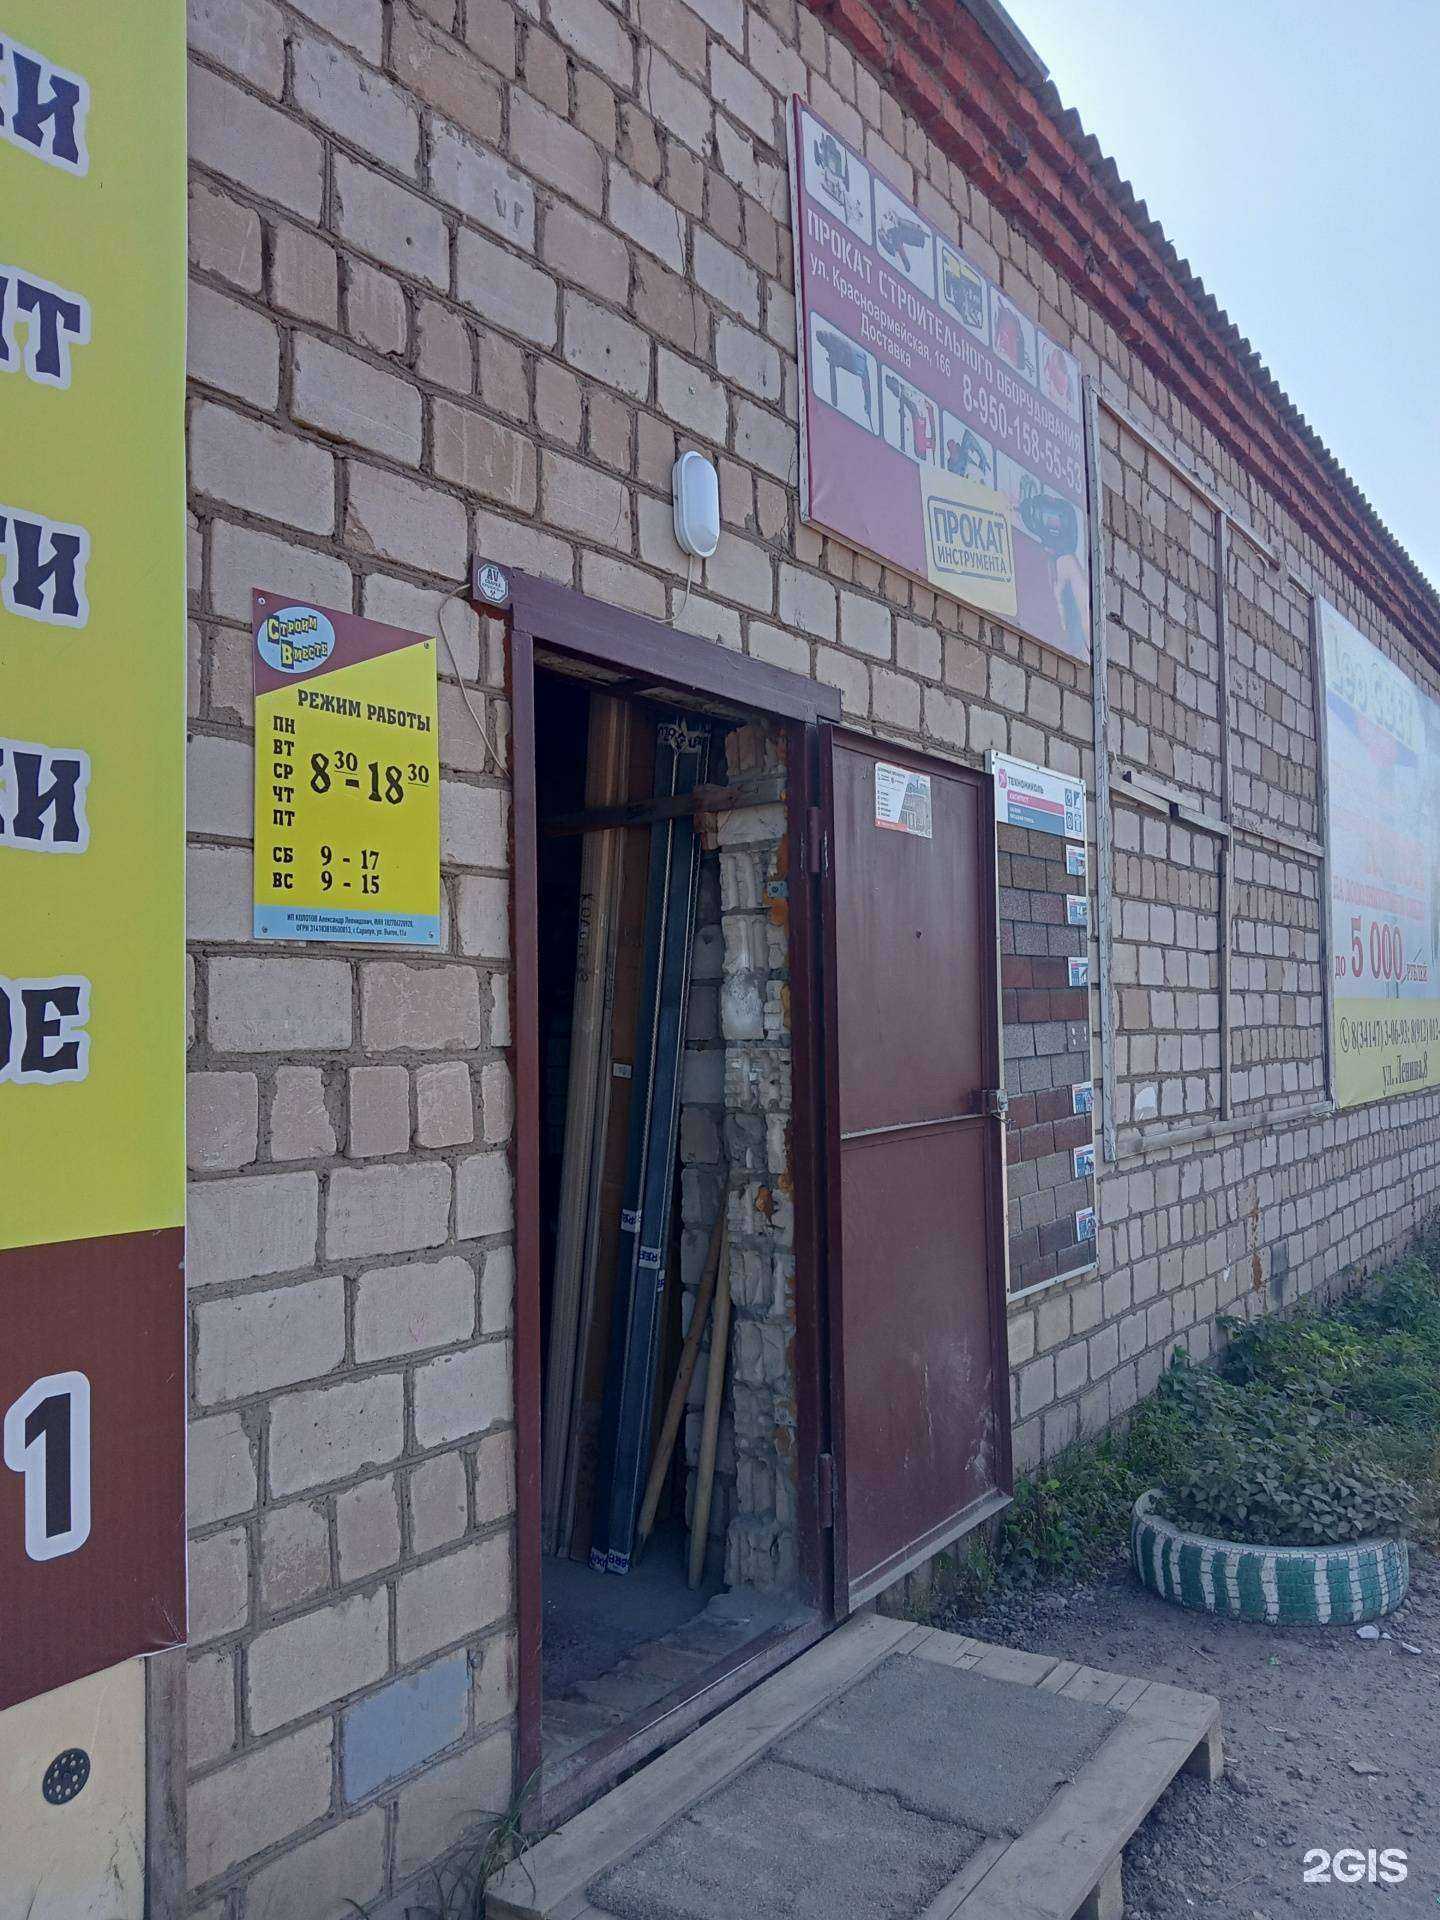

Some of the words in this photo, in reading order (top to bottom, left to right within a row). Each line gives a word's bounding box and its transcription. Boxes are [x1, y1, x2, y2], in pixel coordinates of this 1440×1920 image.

[0, 40, 84, 170] И
[0, 272, 85, 383] Т
[807, 208, 873, 285] ПРОКАТ
[878, 270, 993, 384] СТРОИТЕЛЬНОГО
[996, 370, 1081, 453] ОБОРУДОВАНИЯ
[810, 253, 829, 282] ул.
[832, 267, 933, 367] Красноармейская,
[934, 351, 951, 377] 166
[860, 312, 912, 369] Доставка
[962, 374, 1082, 495] 8-950-158-55-53
[933, 507, 1004, 554] ПРОКАТ
[0, 512, 85, 622] И
[937, 545, 1007, 574] ИНСТРУМЕНТА
[273, 715, 295, 734] ПН
[297, 688, 362, 718] РЕЖИМ
[367, 704, 431, 732] РАБОТЫ
[273, 739, 294, 756] ВТ
[273, 763, 293, 779] СР
[0, 744, 85, 846] И
[272, 785, 294, 803] ЧТ
[273, 809, 295, 826] ПТ
[272, 846, 293, 863] СБ
[320, 845, 332, 866] 9
[361, 850, 379, 870] 17
[272, 872, 293, 889] ВС
[321, 870, 332, 891] 9
[361, 874, 380, 894] 15
[0, 981, 85, 1078] Е
[14, 1382, 80, 1550] 1
